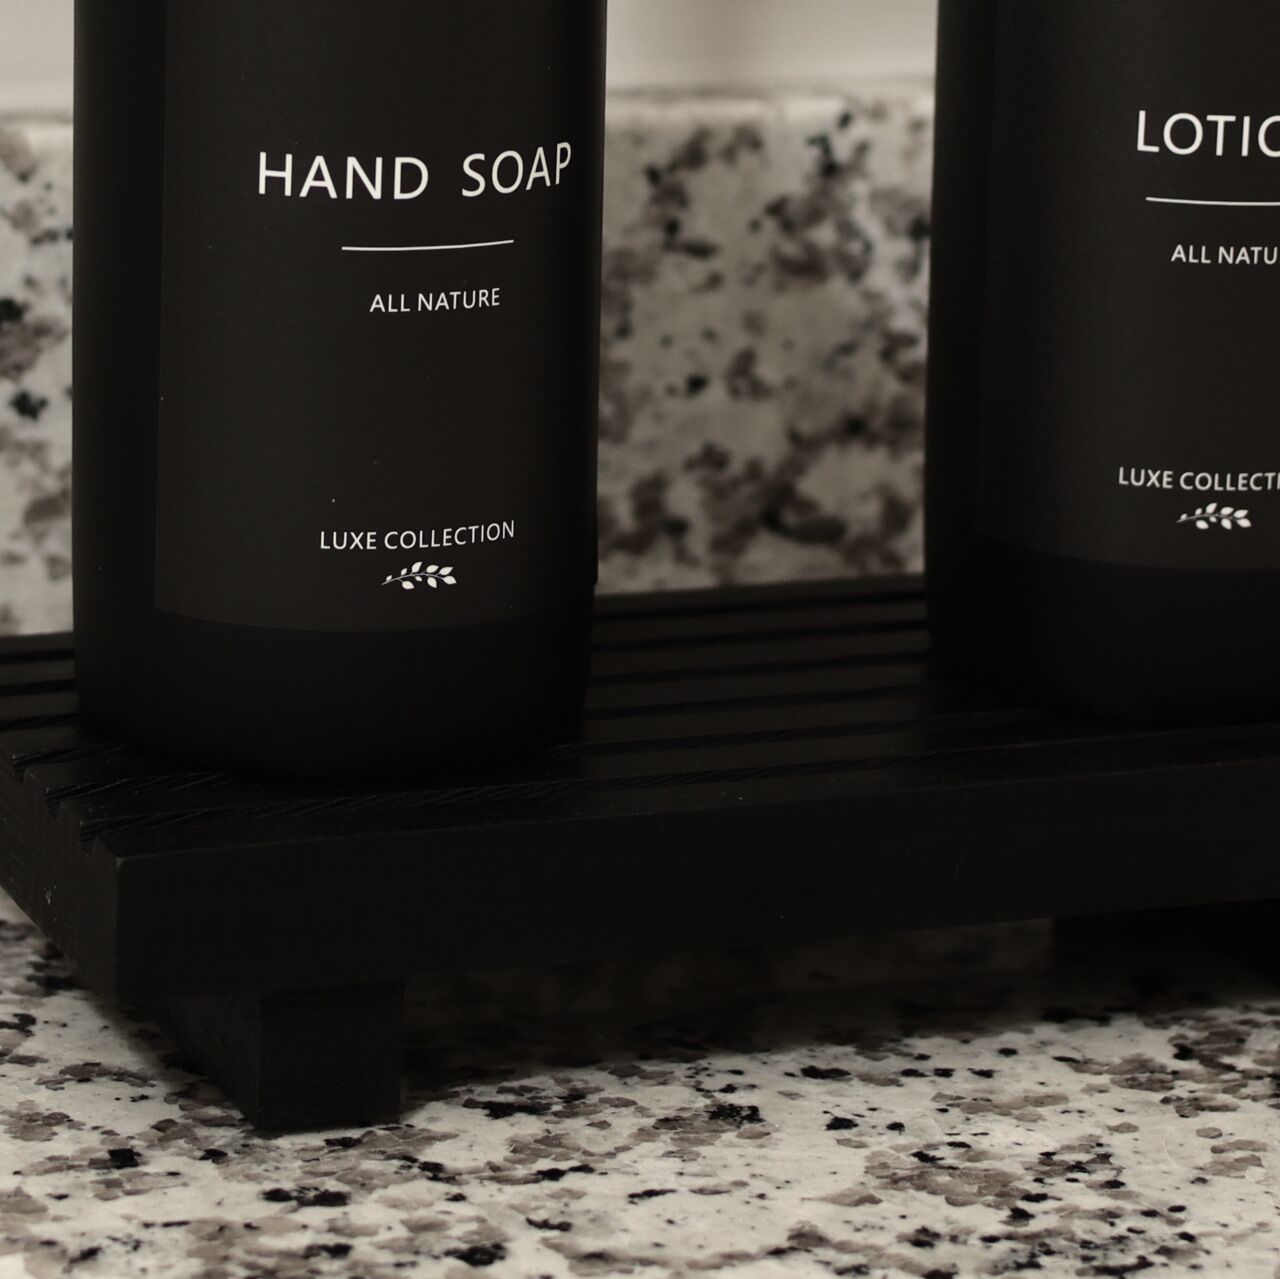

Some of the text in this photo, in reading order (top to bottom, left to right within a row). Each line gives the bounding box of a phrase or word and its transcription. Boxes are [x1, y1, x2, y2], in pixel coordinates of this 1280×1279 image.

[257, 141, 572, 200] HAND SOAP
[1170, 243, 1212, 264] ALL
[369, 287, 501, 313] ALL NATURE
[1118, 466, 1174, 489] LUXE
[320, 519, 515, 550] LUXE COLLECTION
